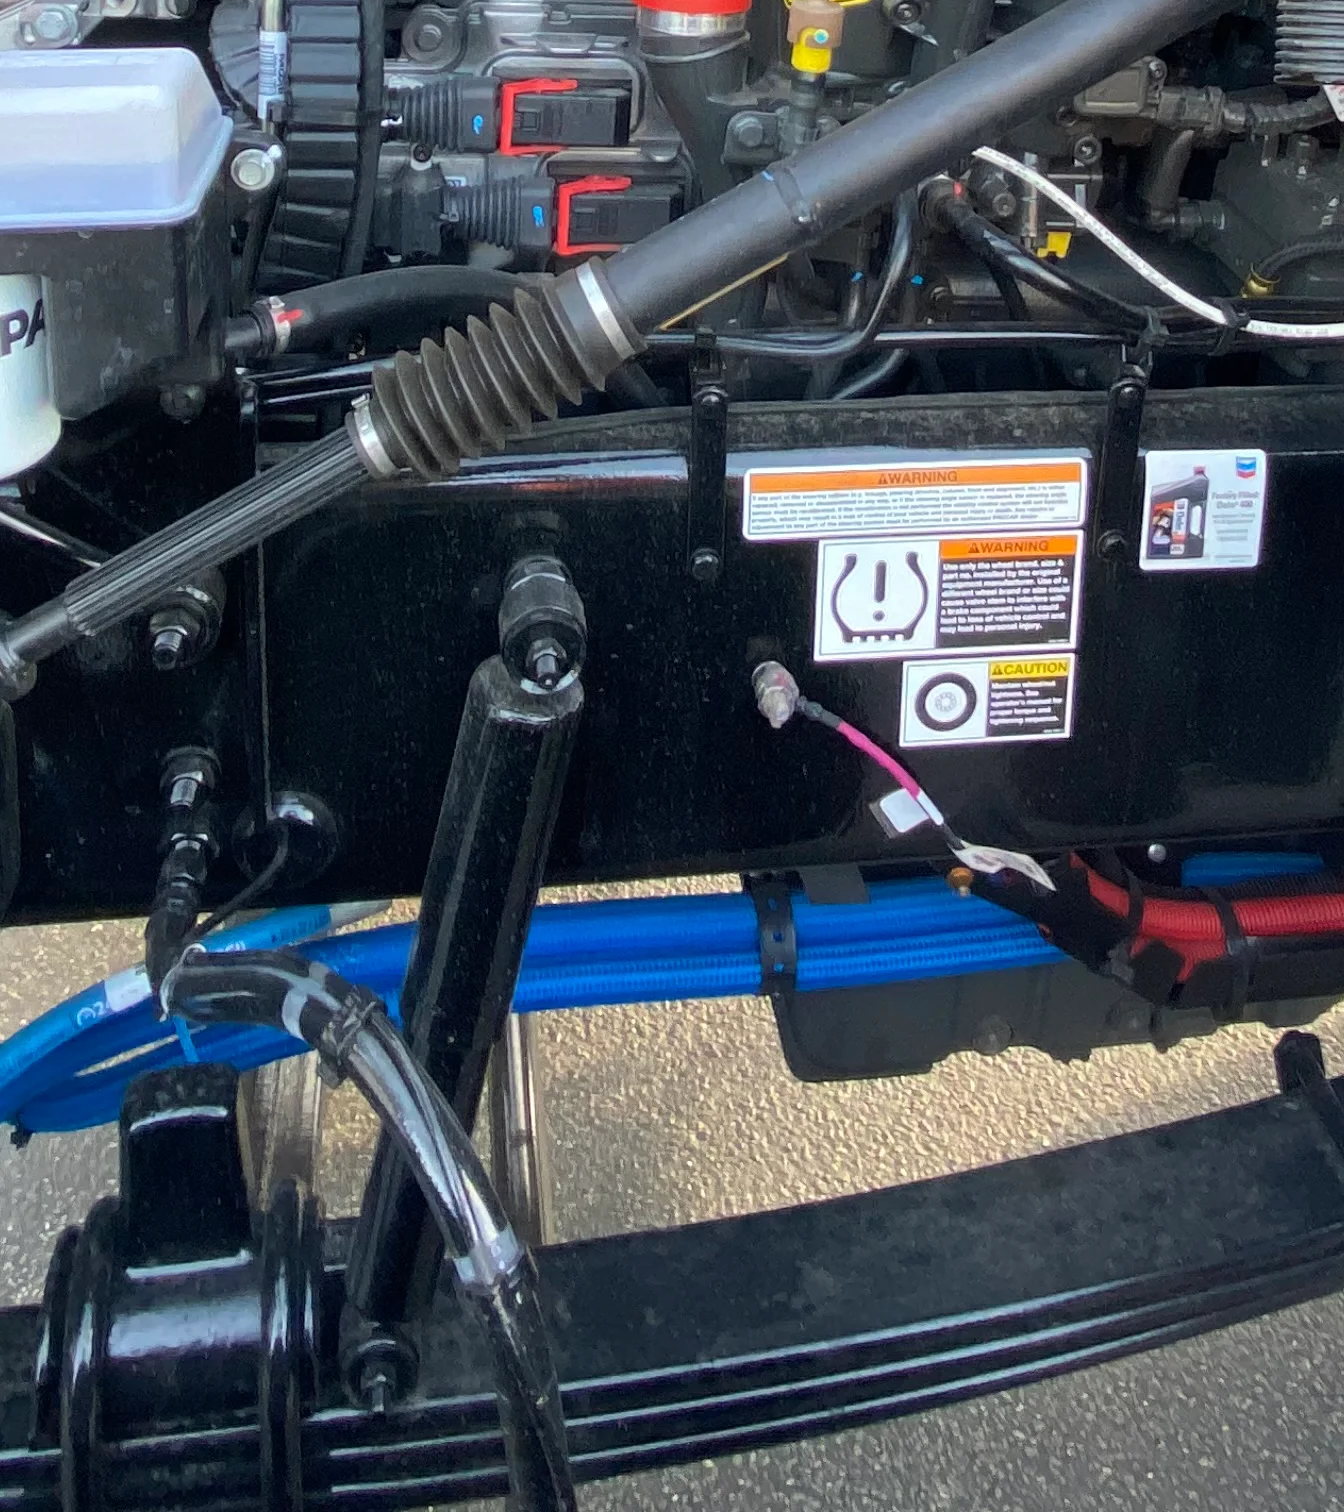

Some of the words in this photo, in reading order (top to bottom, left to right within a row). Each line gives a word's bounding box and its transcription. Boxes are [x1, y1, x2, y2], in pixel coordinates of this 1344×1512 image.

[888, 471, 957, 484] WARNING
[980, 540, 1048, 553] WARNING
[1004, 662, 1067, 675] CAUTION
